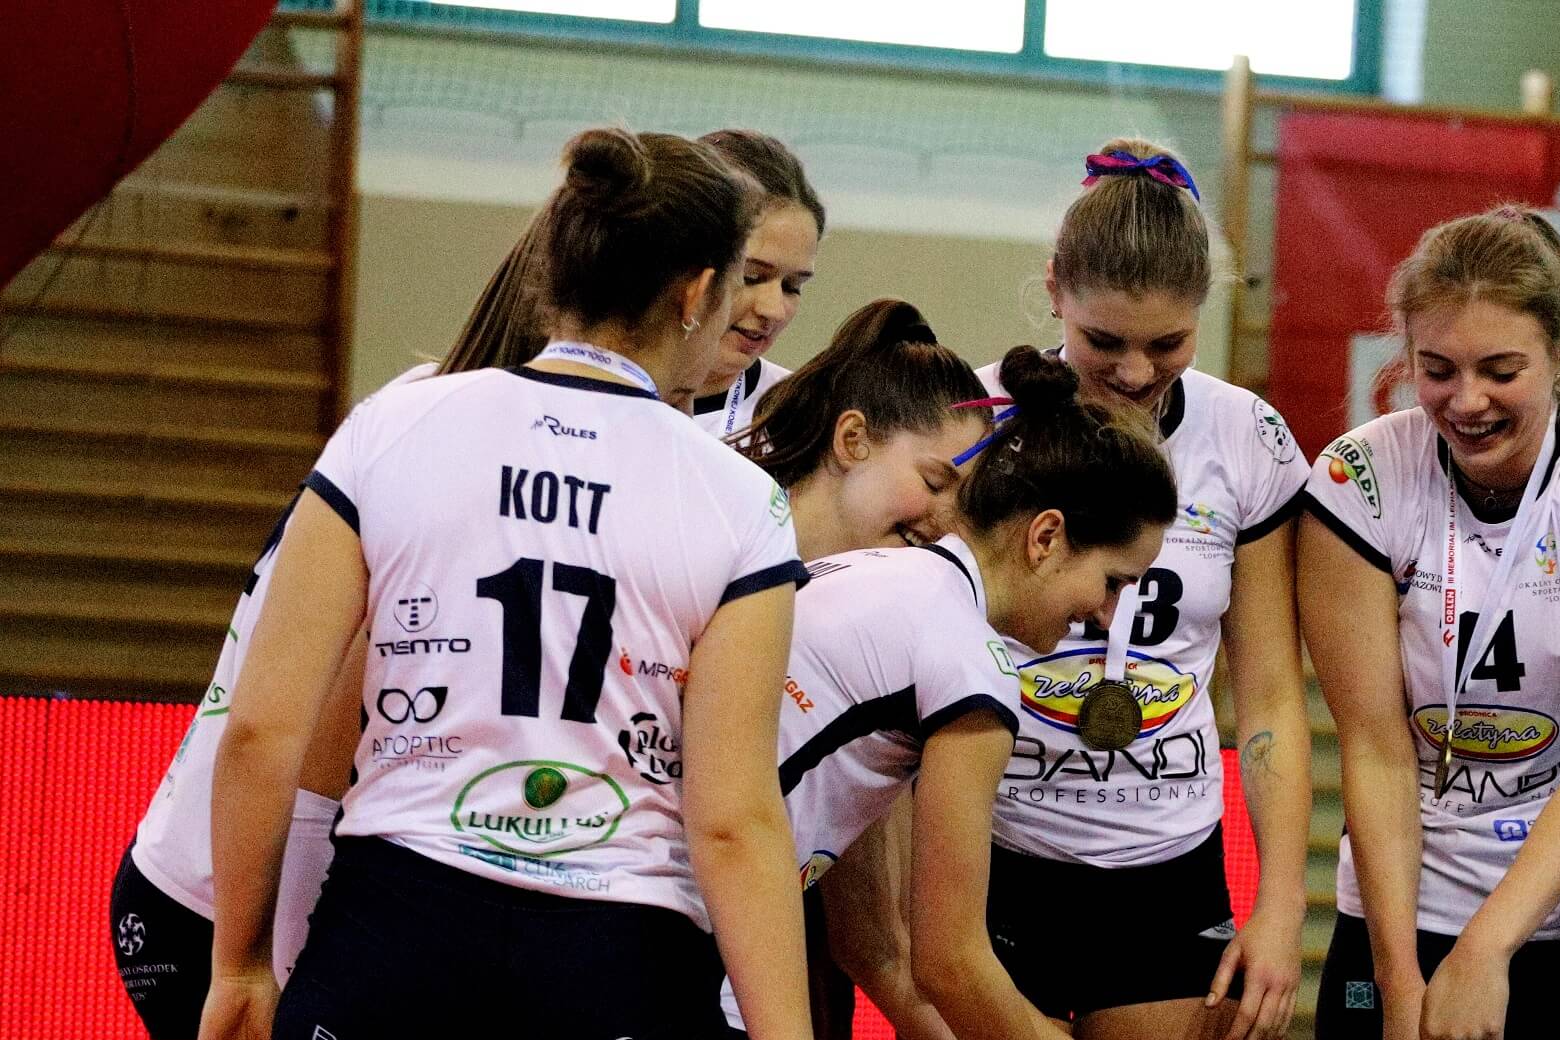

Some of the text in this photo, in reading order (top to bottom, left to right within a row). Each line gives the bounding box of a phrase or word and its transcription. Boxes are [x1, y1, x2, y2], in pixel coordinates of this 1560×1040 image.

[725, 408, 735, 434] KOBIE
[500, 463, 611, 535] KOTT
[1445, 589, 1456, 624] ORLEN
[476, 556, 617, 724] 17
[1034, 671, 1180, 705] zelyna
[1004, 729, 1207, 782] BANDI
[1008, 783, 1207, 804] ROFESSIONAL
[468, 811, 606, 836] LUKULUS
